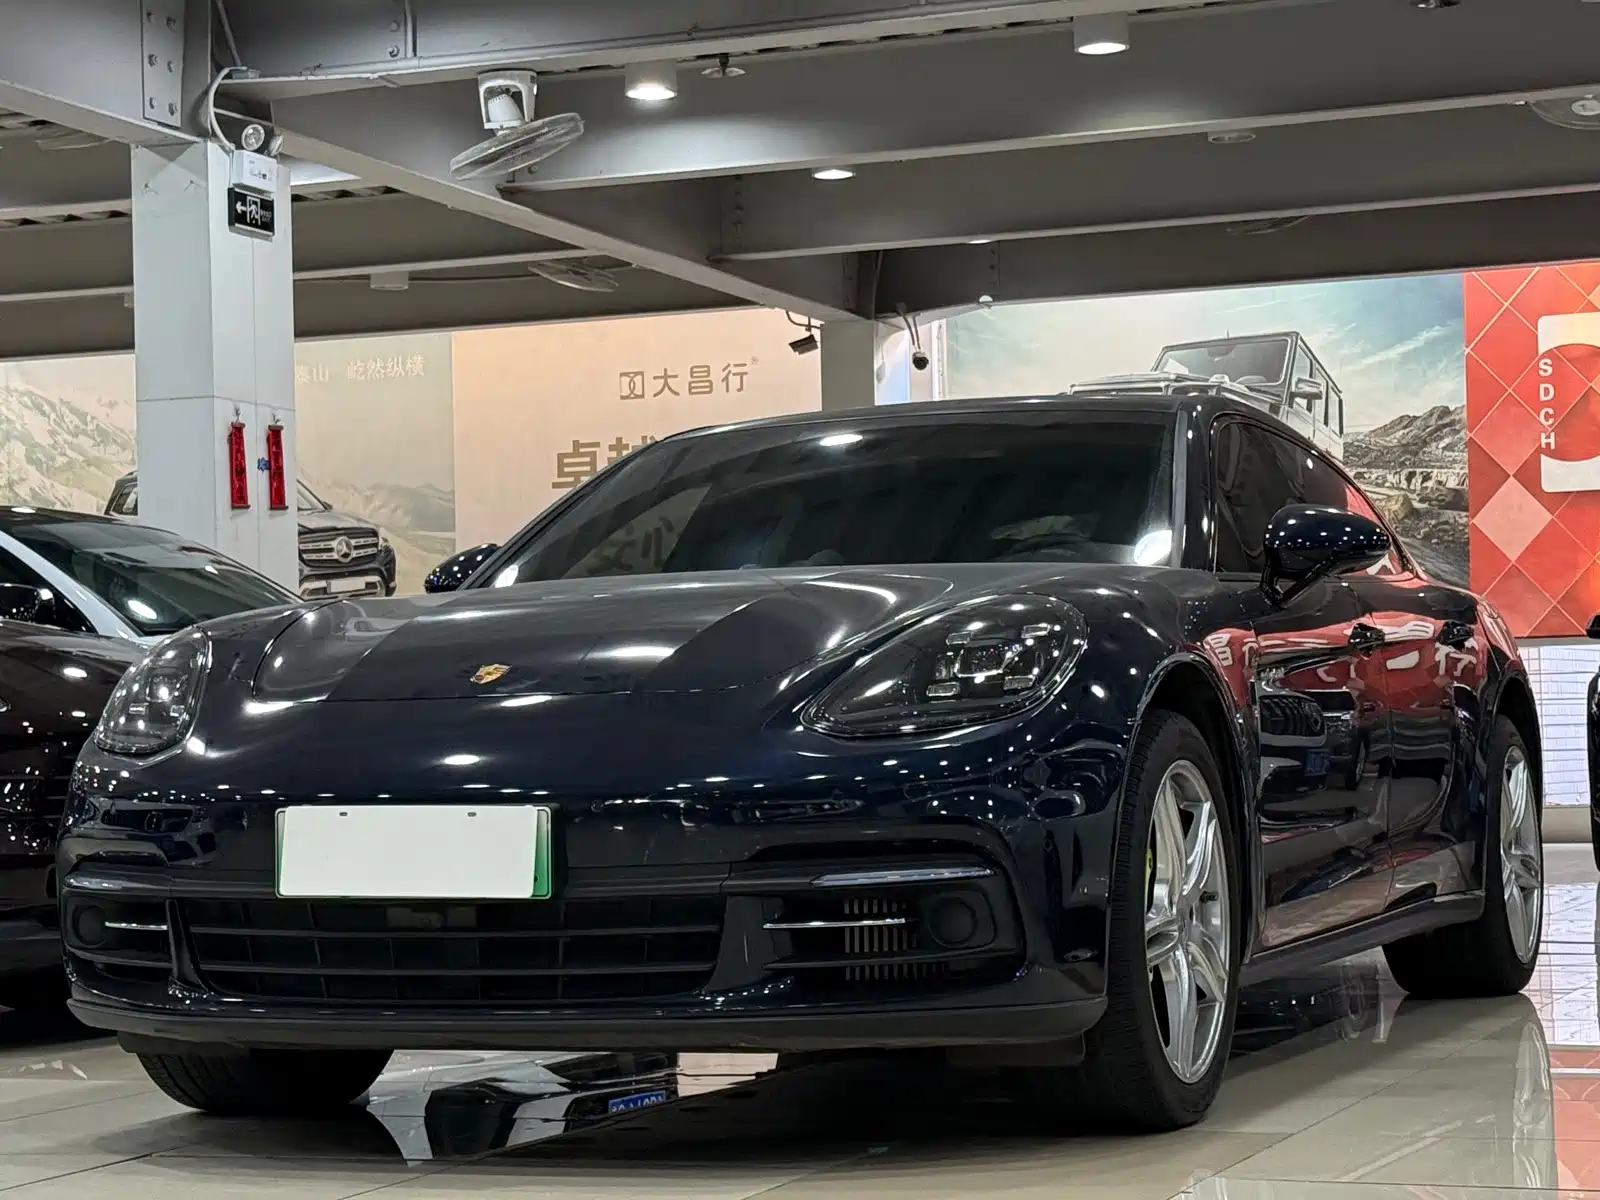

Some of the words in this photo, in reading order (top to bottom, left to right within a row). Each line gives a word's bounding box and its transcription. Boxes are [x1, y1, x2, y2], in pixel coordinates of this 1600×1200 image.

[347, 352, 426, 381] 屹然纵横
[652, 362, 749, 398] 大昌行
[1538, 358, 1556, 449] SDCH
